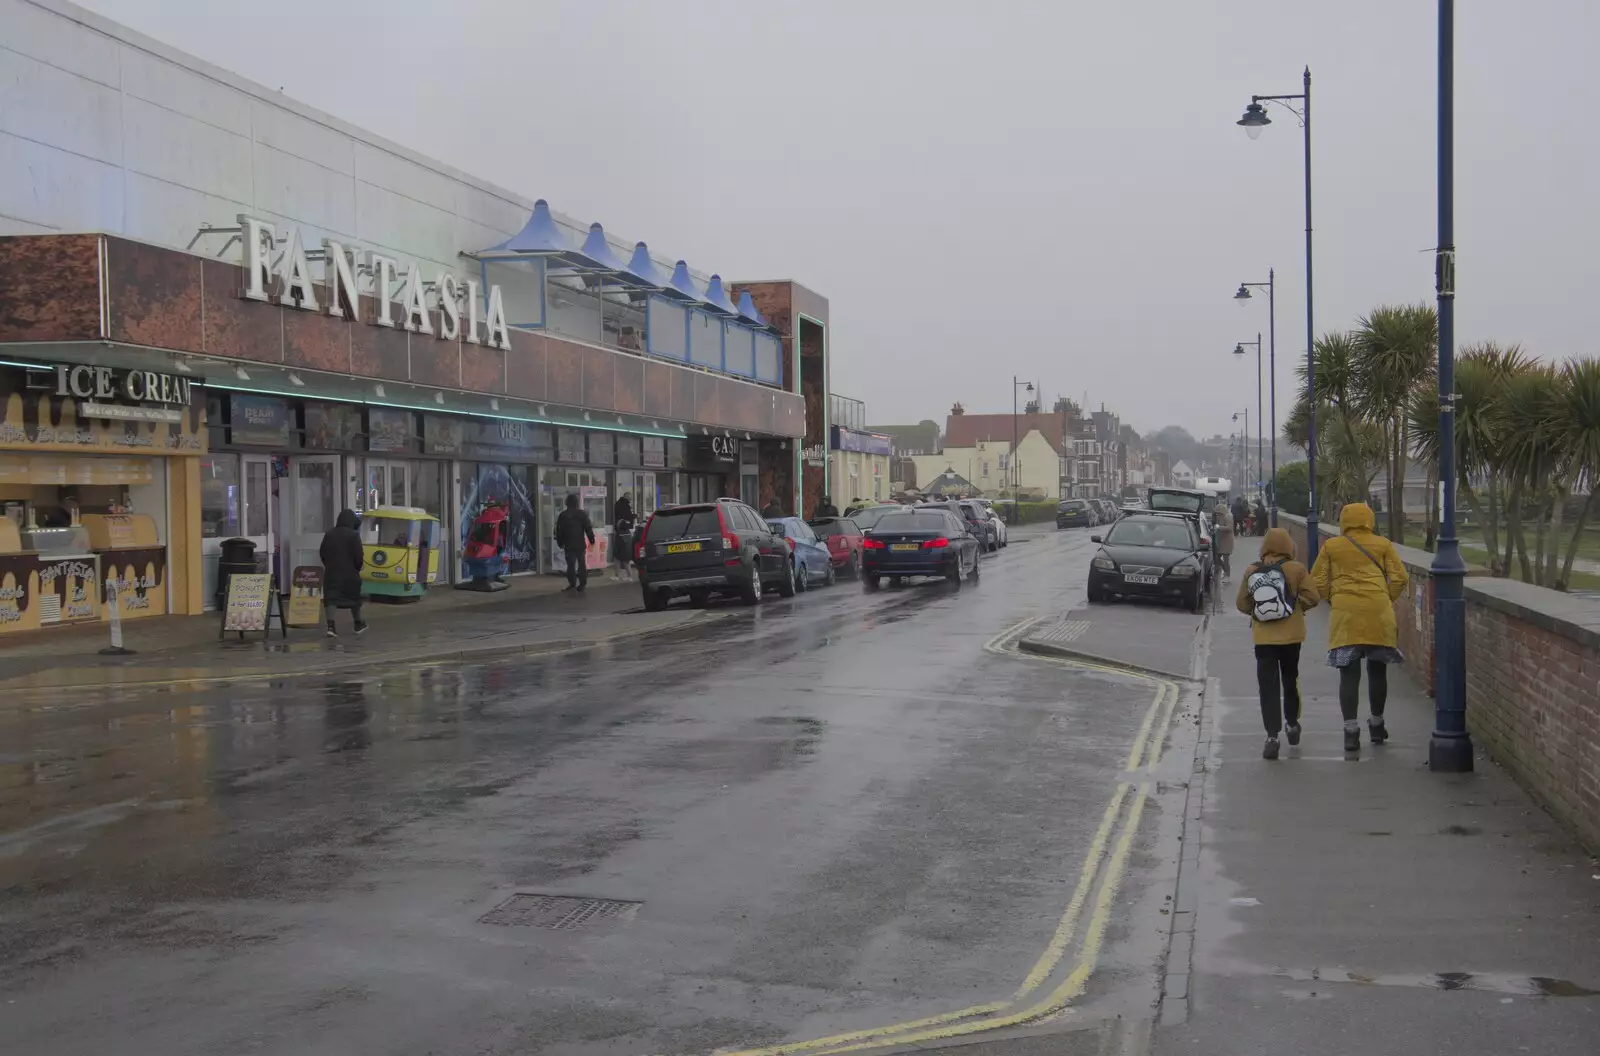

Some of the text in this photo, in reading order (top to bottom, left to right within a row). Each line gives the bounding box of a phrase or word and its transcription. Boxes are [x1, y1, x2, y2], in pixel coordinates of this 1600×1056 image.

[237, 214, 512, 351] FANTASIA
[56, 364, 192, 405] ICE CREAM
